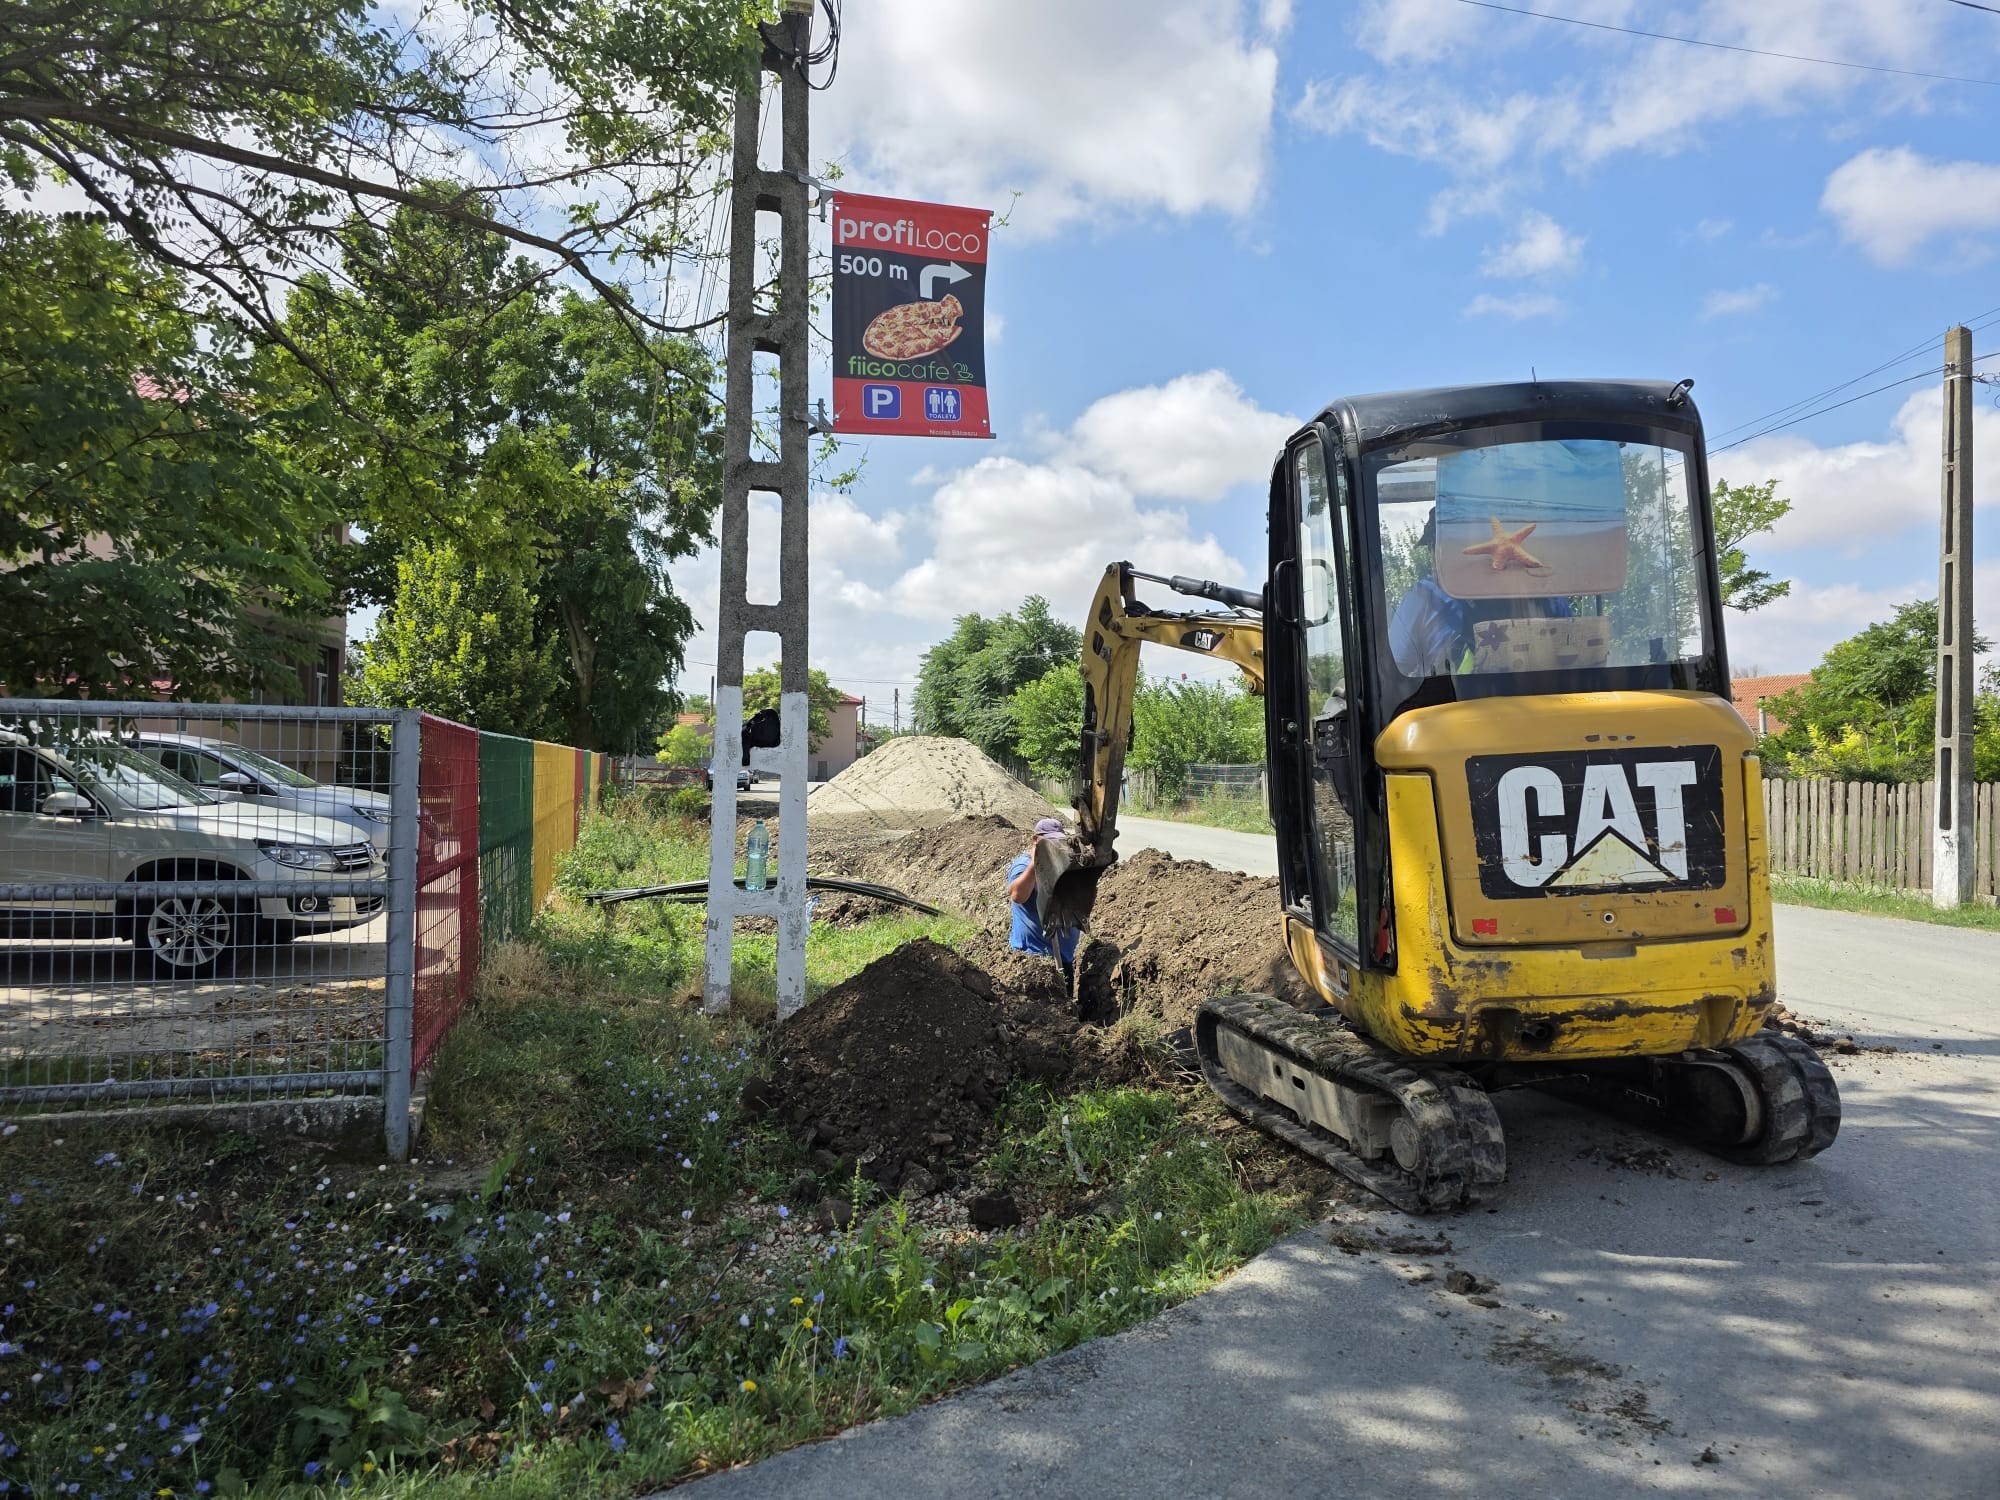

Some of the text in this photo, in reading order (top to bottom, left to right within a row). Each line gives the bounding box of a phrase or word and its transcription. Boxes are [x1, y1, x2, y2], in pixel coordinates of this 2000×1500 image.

[839, 254, 908, 281] 500 m
[872, 389, 893, 414] P
[1194, 631, 1213, 650] CAT
[1497, 760, 1698, 888] CAT
